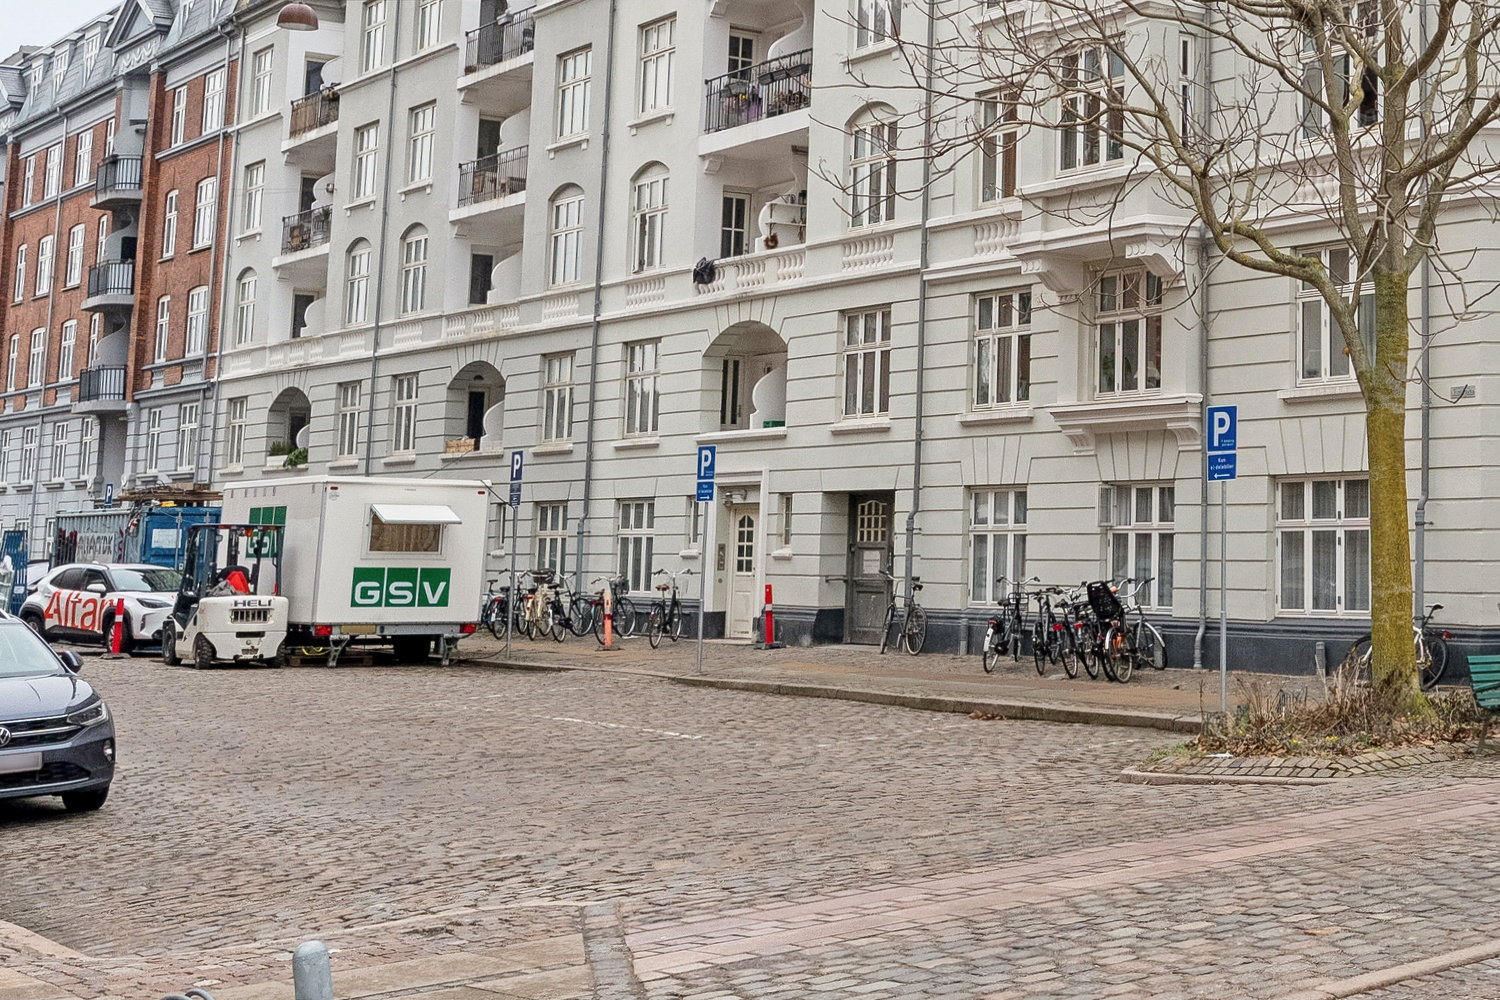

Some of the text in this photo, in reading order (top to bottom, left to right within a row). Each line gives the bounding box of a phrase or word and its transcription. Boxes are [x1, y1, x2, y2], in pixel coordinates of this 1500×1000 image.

[1213, 411, 1231, 447] P
[513, 454, 521, 478] P
[701, 449, 712, 477] P
[106, 485, 112, 502] P
[234, 600, 272, 608] HELI
[354, 581, 447, 605] GSV
